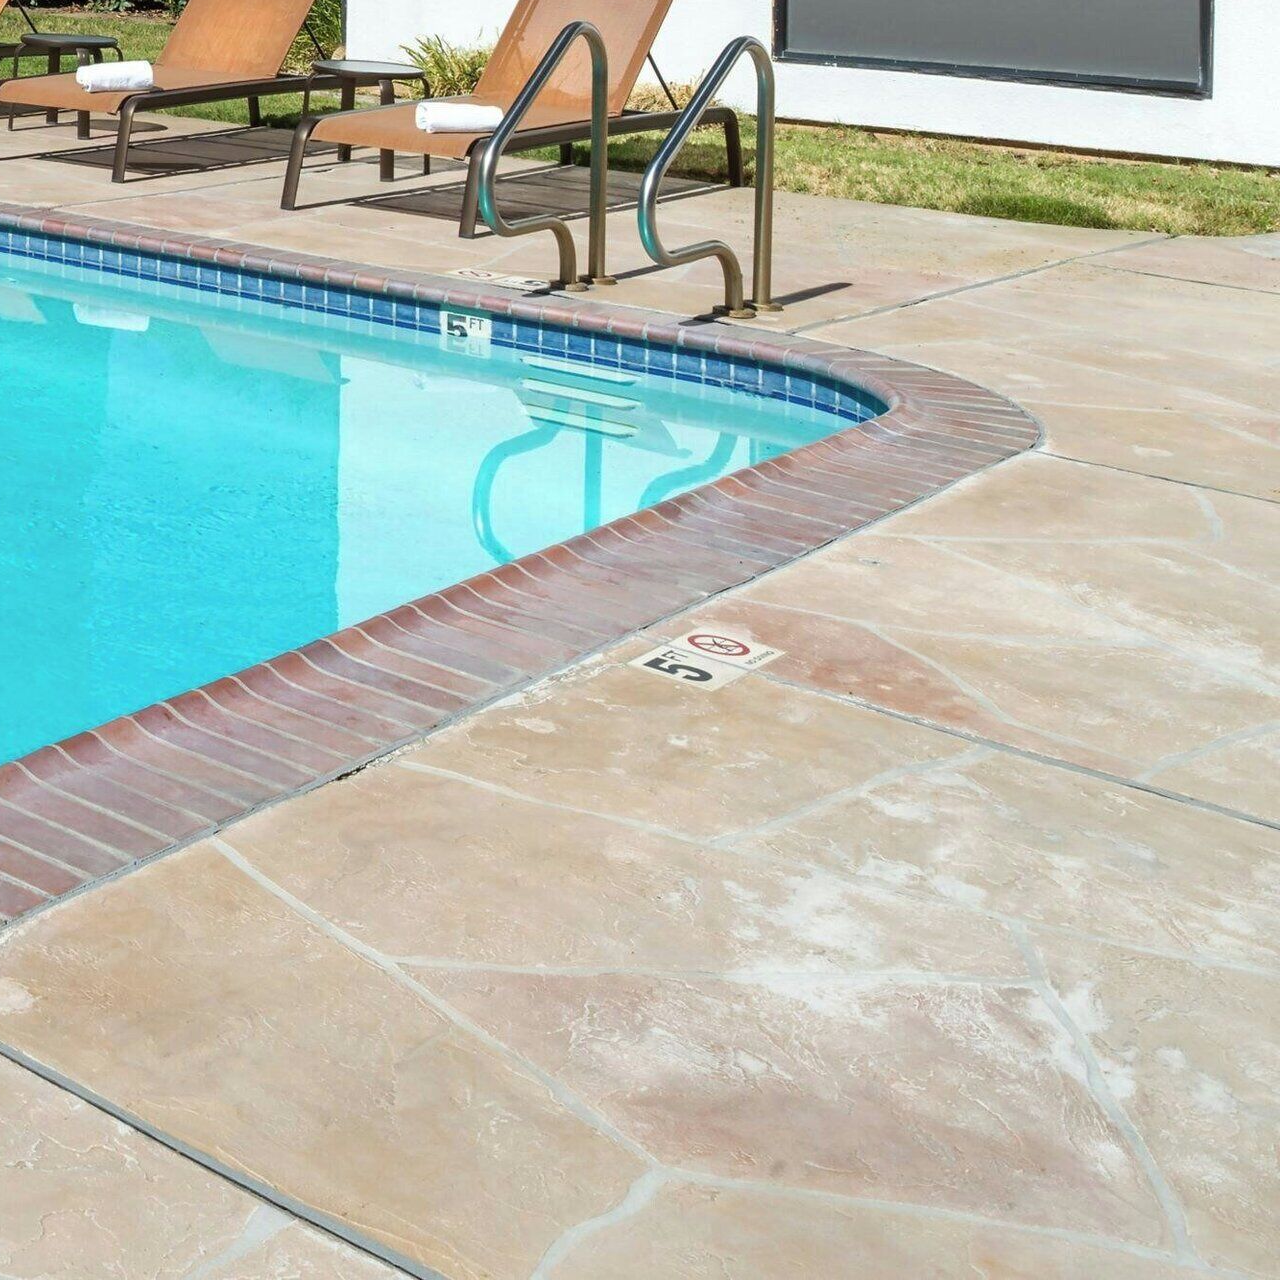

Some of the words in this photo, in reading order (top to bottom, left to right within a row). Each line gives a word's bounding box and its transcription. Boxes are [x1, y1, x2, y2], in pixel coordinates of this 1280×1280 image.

[447, 313, 468, 337] 5
[470, 317, 484, 331] FT
[643, 657, 713, 682] 5
